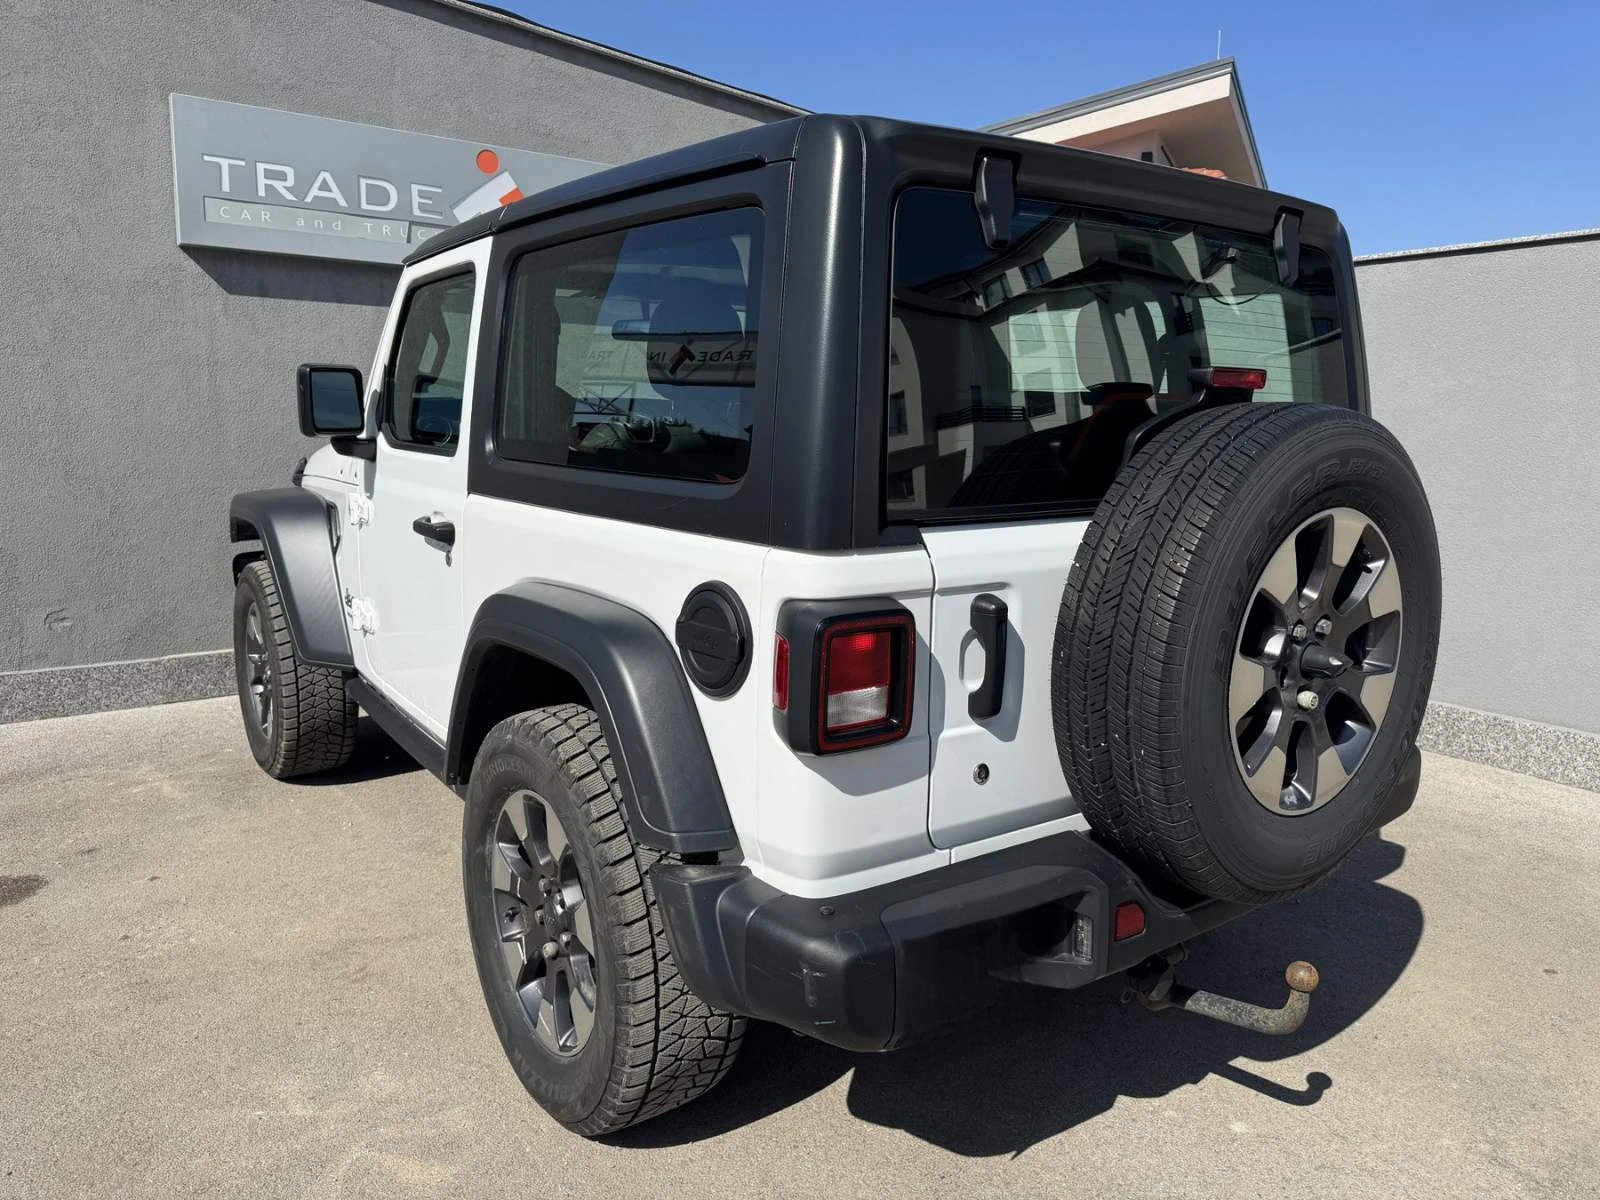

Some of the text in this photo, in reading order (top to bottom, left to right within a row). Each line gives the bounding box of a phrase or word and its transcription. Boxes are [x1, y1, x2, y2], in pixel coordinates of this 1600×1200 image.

[202, 154, 443, 219] TRADE
[219, 205, 438, 241] CAR and TRUC
